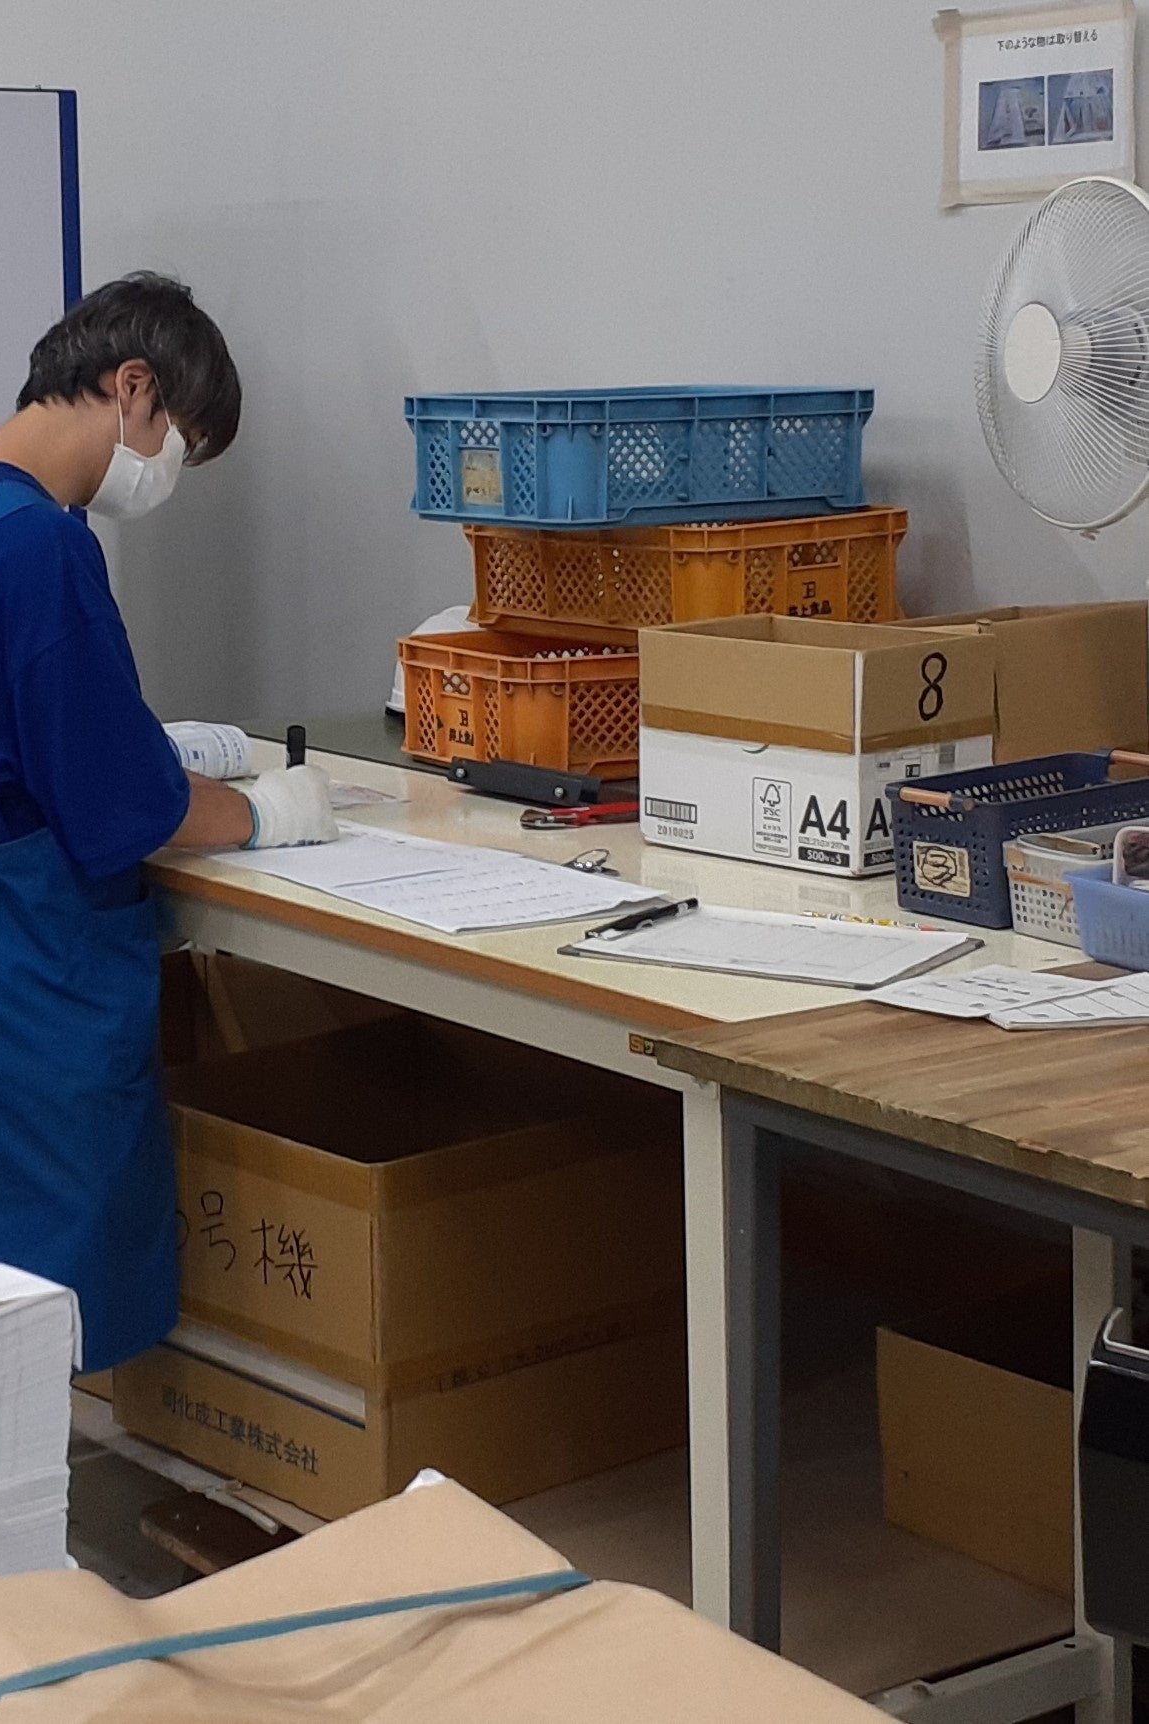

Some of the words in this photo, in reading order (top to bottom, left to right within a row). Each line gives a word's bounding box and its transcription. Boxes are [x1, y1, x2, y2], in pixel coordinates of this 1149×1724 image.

[997, 29, 1098, 51] 下のような物は取り替える
[918, 651, 948, 722] 8
[763, 807, 781, 817] FSC
[799, 795, 850, 841] A4
[865, 798, 894, 841] A
